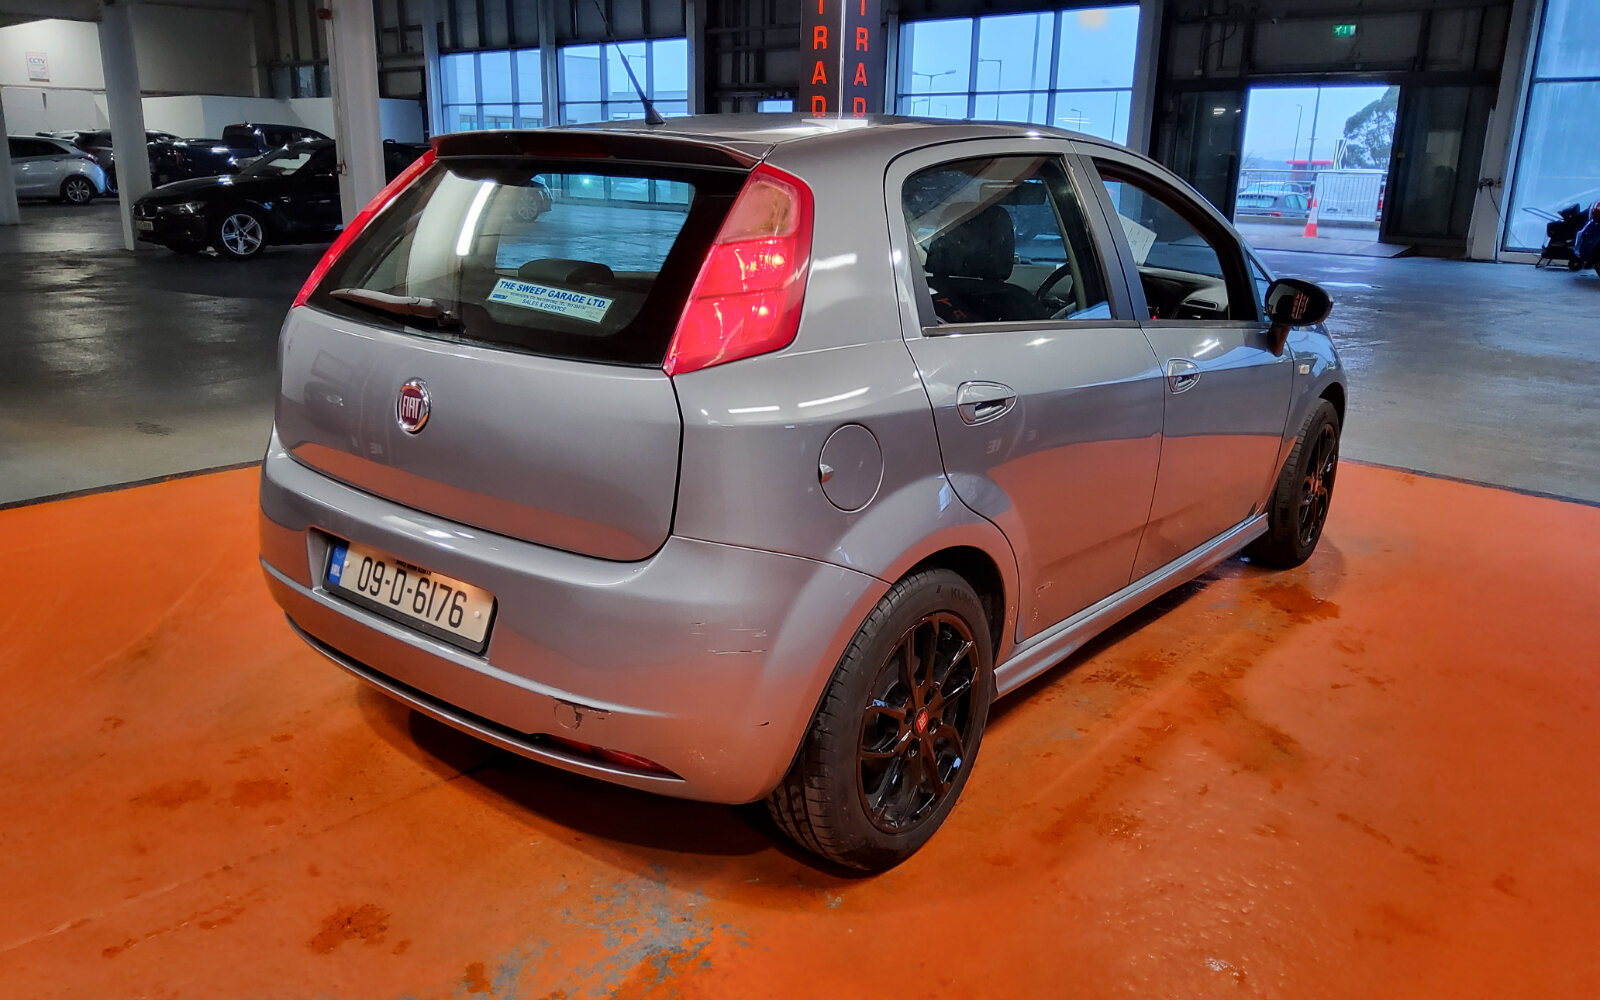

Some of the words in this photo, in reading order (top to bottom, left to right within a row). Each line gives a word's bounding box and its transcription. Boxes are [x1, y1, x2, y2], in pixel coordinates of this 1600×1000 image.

[500, 281, 517, 290] THE
[517, 284, 547, 295] SWEEP
[548, 290, 586, 304] GARAGE
[587, 298, 606, 309] LTD.
[522, 299, 539, 307] SALES
[544, 303, 567, 312] SERVICE
[402, 395, 421, 420] FIAT
[357, 556, 467, 629] 09-D-6176
